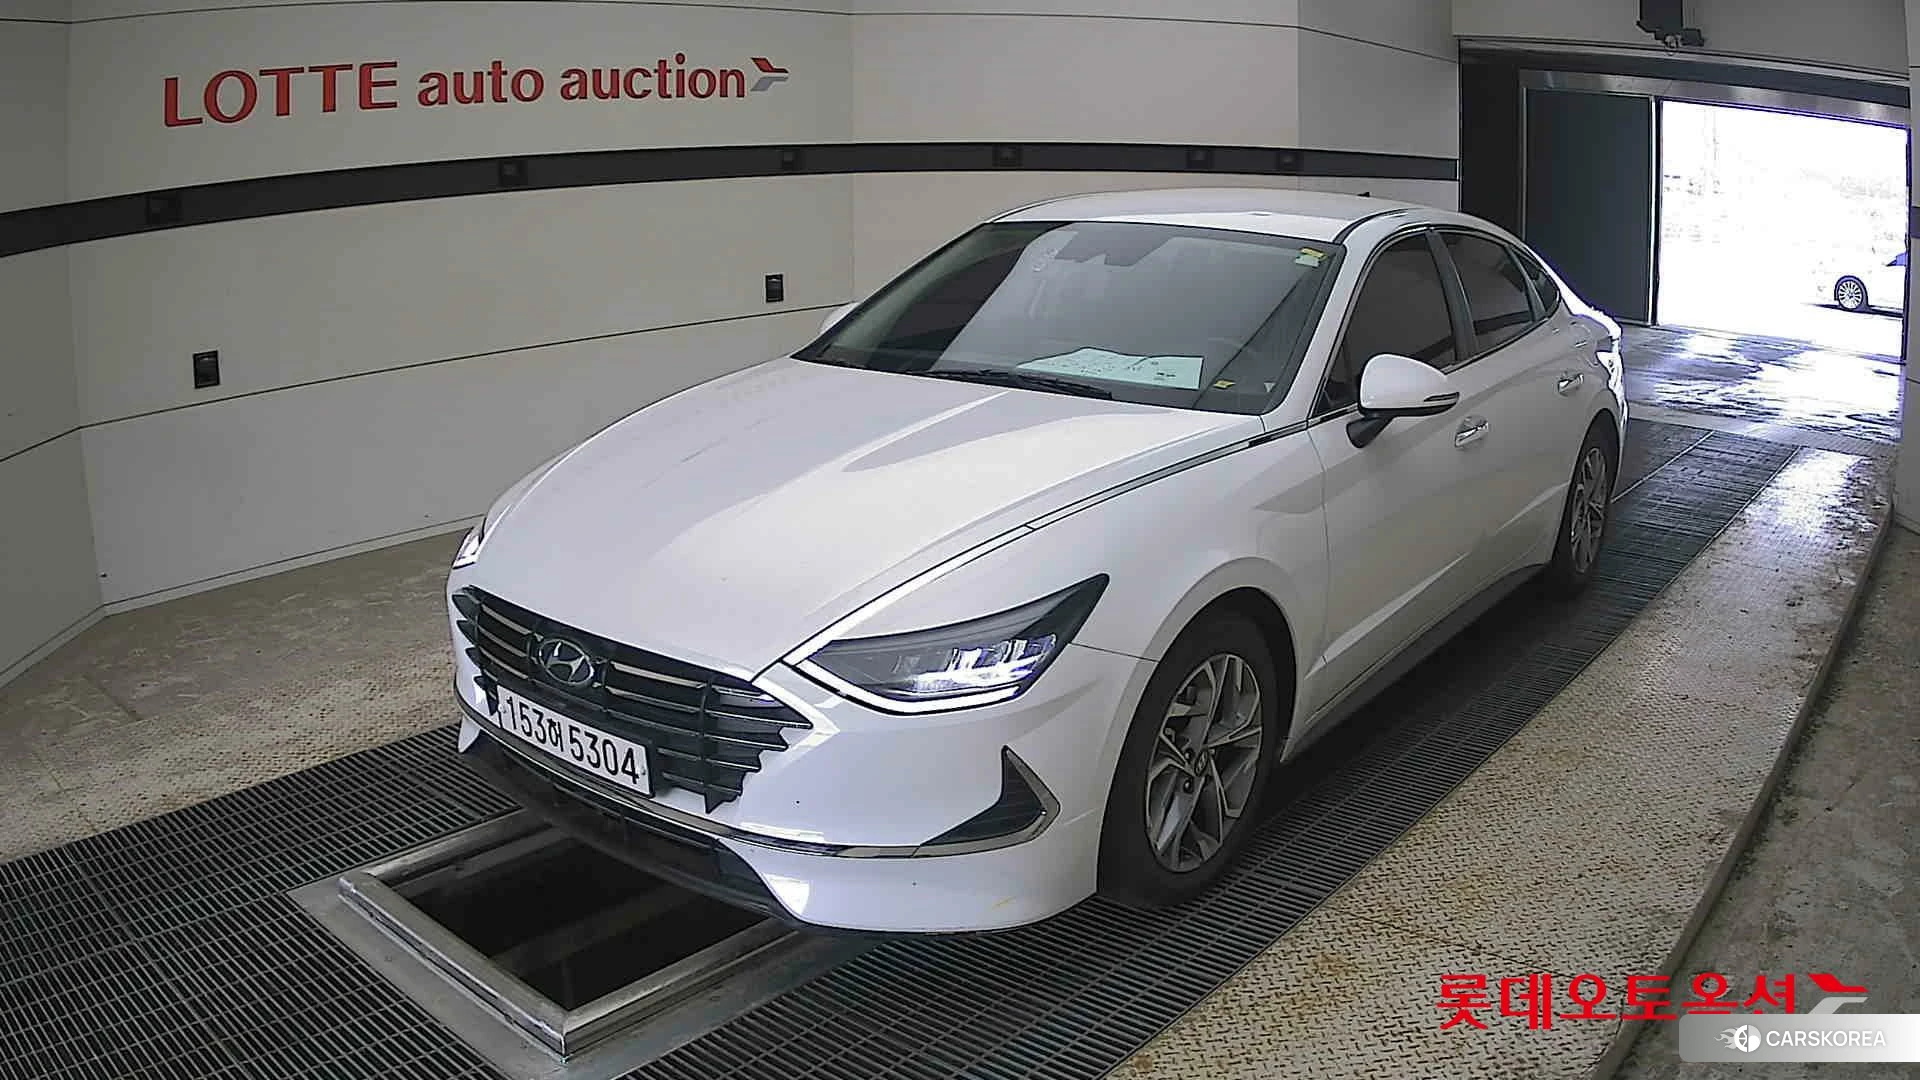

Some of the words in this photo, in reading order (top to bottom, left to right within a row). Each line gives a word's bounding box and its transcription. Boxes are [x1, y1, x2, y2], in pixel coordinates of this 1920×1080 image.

[164, 61, 398, 127] LOTTE
[417, 60, 545, 106] auto
[561, 53, 746, 100] auction
[506, 695, 564, 752] 153허
[568, 724, 640, 785] 5304
